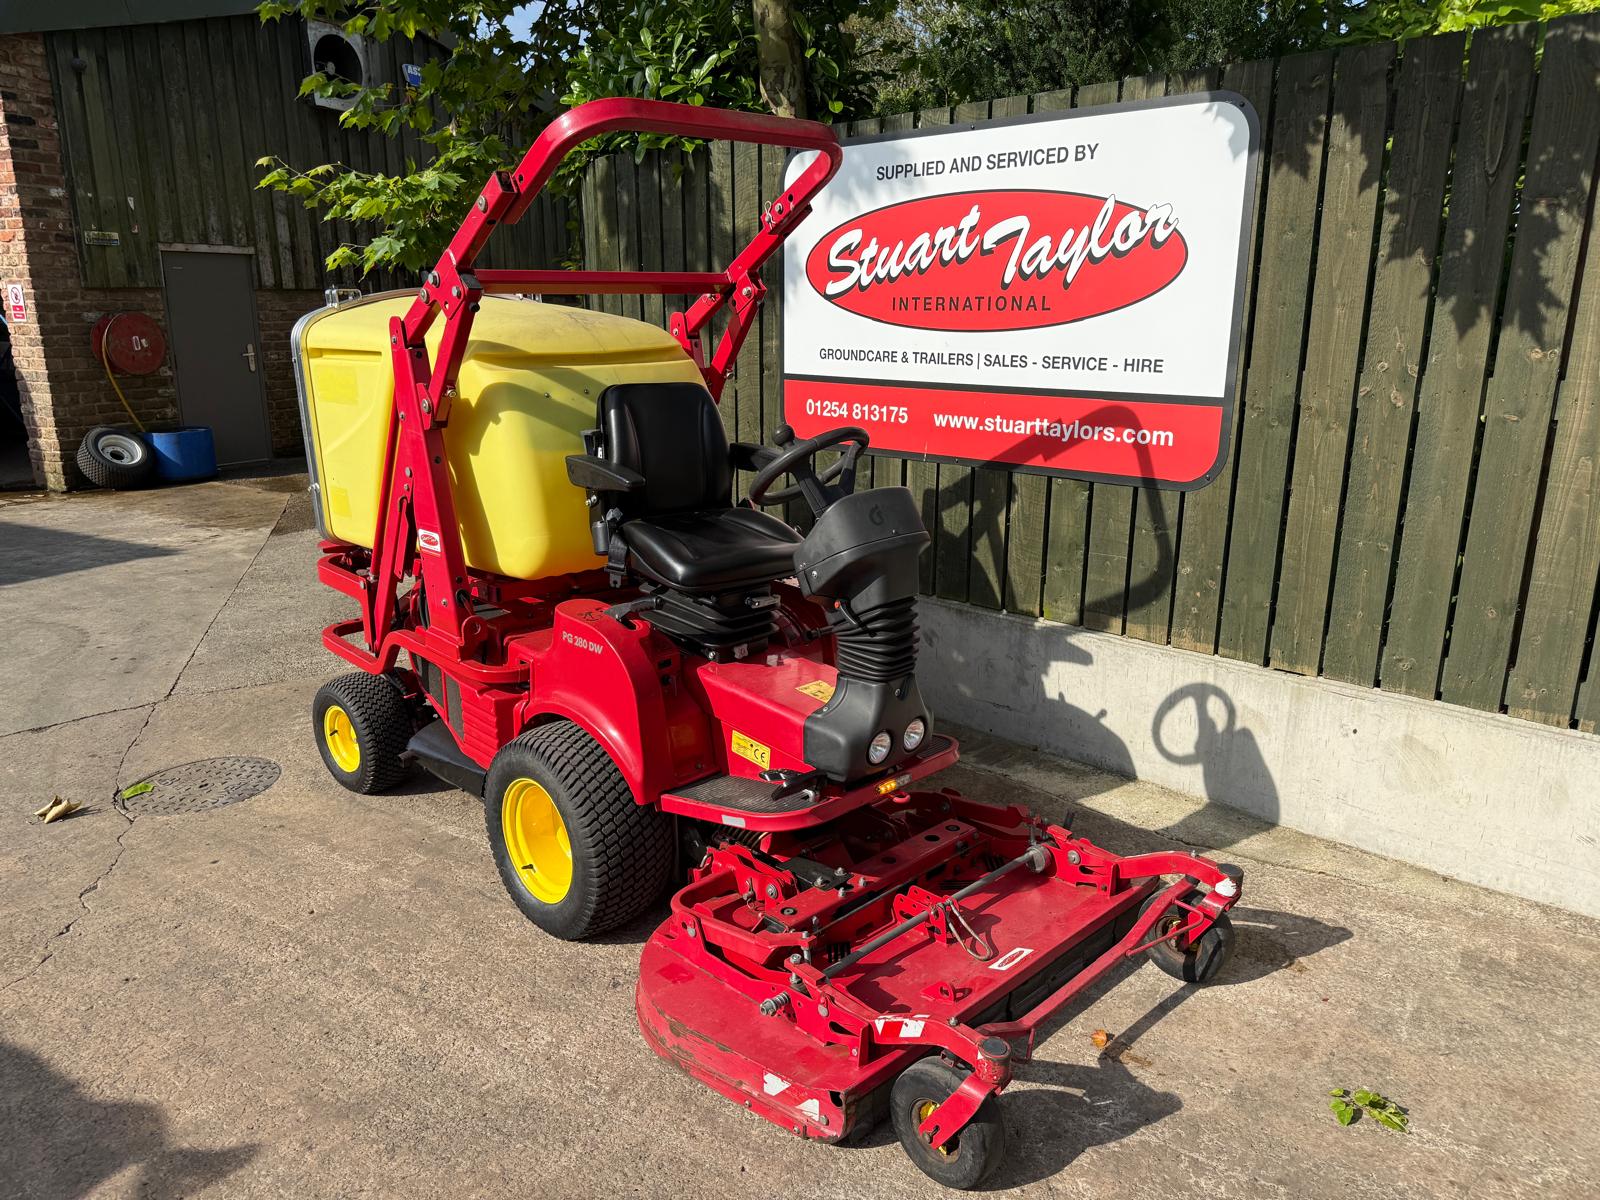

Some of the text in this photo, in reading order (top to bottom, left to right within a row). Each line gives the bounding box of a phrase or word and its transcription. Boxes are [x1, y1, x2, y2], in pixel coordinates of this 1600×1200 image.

[876, 143, 1099, 181] SUPPLIED AND SERVICED BY
[824, 194, 1179, 299] Stuart Taylor
[892, 295, 1051, 312] INTERNATIONAL
[819, 348, 898, 363] GROUNDCARE
[901, 351, 909, 363] &
[912, 352, 974, 367] TRAILERS
[983, 354, 1028, 369] SALES
[1041, 355, 1108, 371] SERVICE
[1123, 358, 1164, 374] HIRE
[806, 398, 1174, 447] 01254 813175 www.stuarttaylors.com
[562, 631, 604, 655] PG 280 DW
